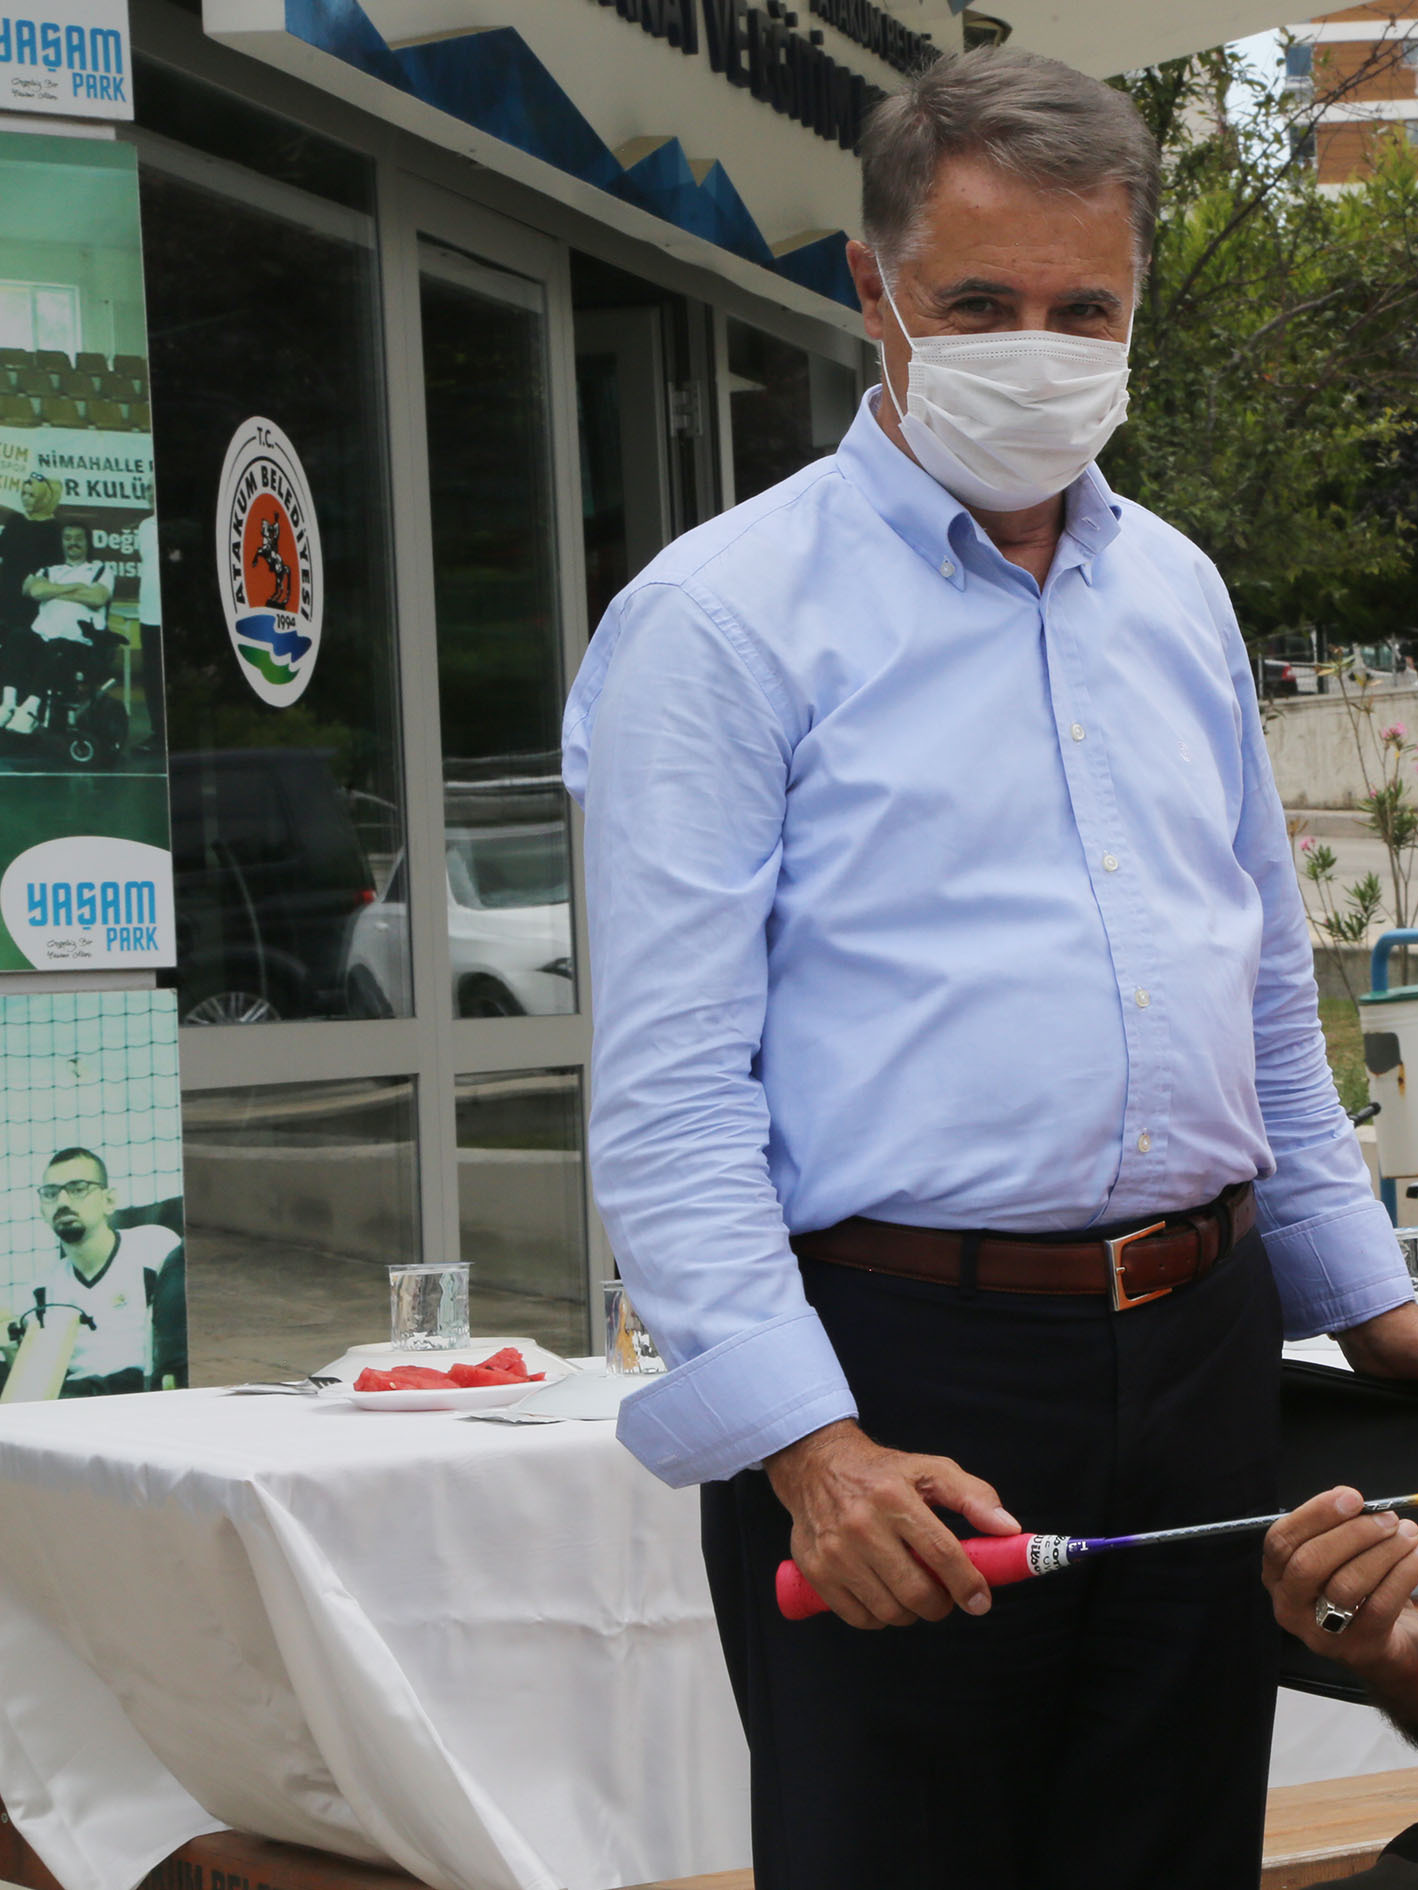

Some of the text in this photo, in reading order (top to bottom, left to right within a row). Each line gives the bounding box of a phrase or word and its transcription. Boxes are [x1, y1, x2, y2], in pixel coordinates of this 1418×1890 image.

[72, 72, 126, 102] PARK
[231, 470, 257, 606] ATAKUM
[276, 613, 296, 630] 1994
[27, 881, 157, 930] YAŞAM
[106, 926, 159, 951] PARK
